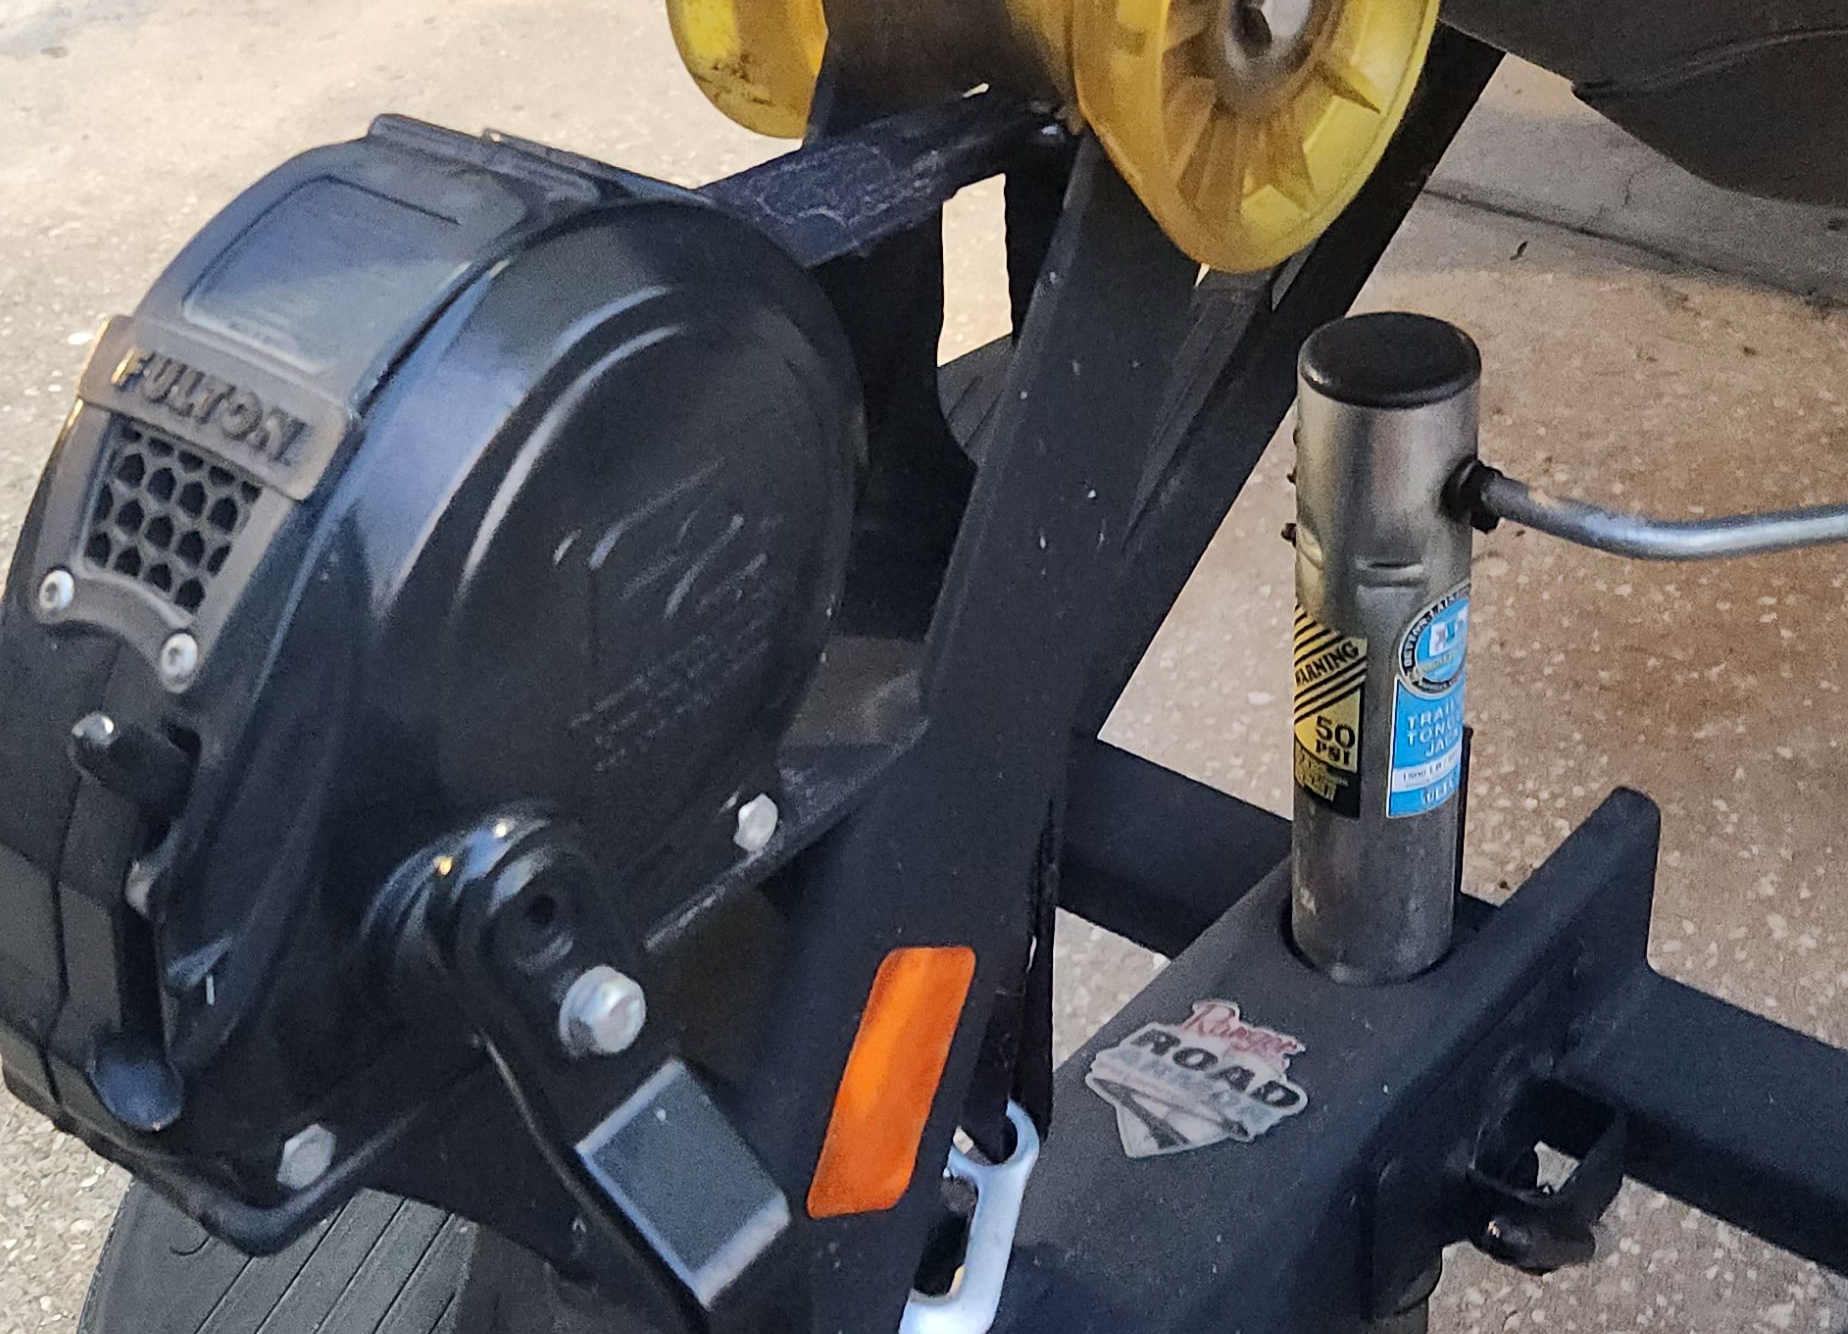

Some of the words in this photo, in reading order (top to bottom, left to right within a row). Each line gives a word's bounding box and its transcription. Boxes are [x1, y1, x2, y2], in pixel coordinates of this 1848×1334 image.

[112, 347, 306, 462] FULTON
[1315, 715, 1356, 749] 50
[1315, 739, 1351, 766] PSI
[1178, 1002, 1298, 1057] Ranger
[1130, 1028, 1301, 1108] ROAD
